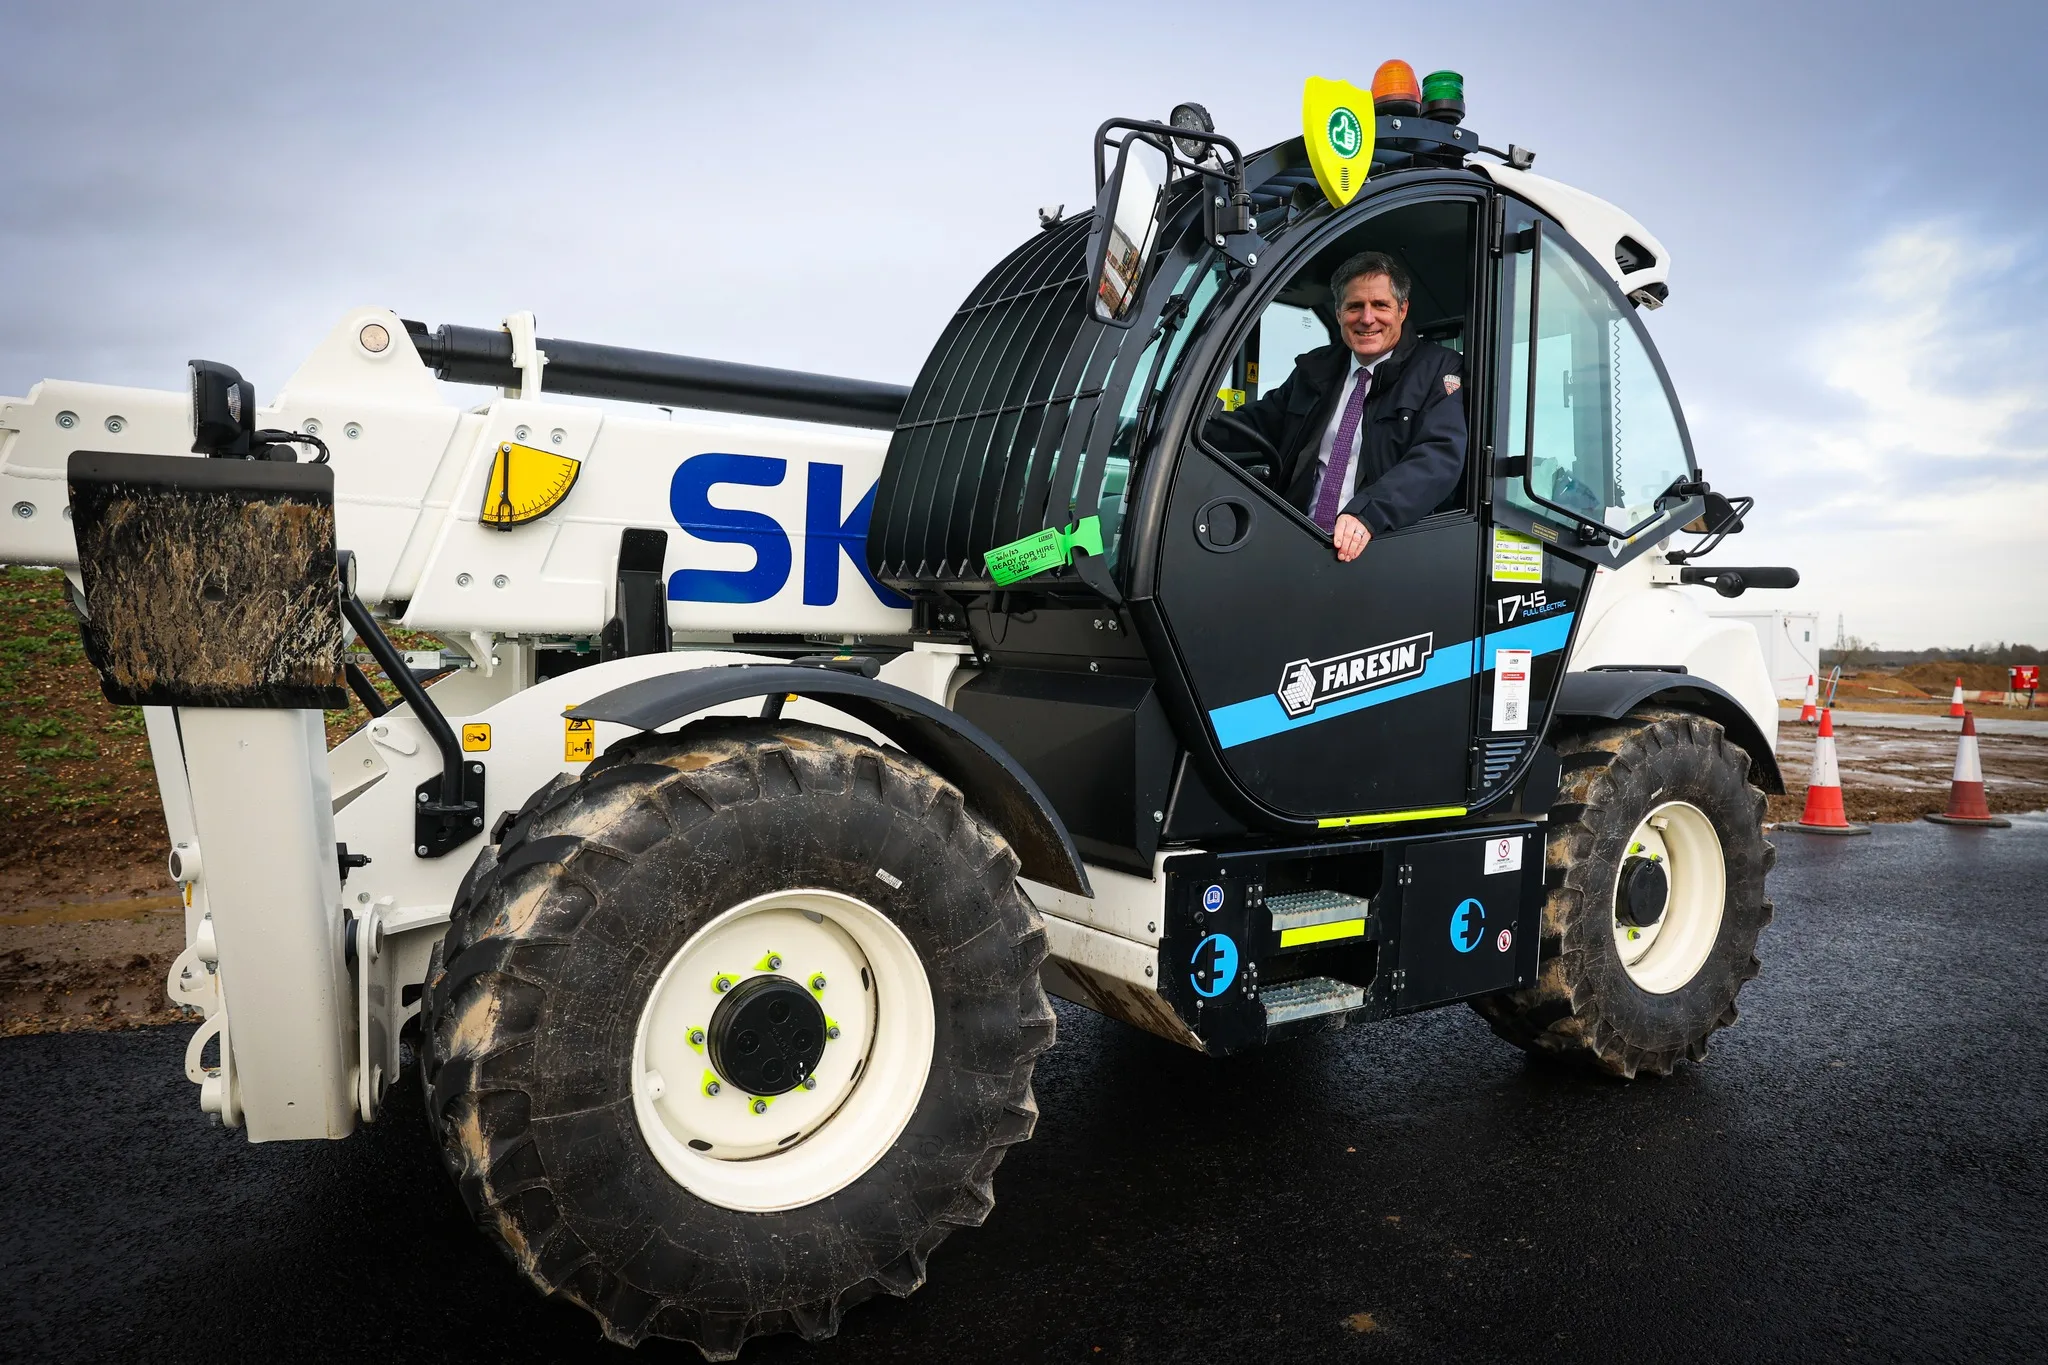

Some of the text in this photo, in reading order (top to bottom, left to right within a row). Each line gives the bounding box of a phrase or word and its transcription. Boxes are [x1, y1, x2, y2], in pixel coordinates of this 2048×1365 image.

[992, 557, 1017, 571] READY
[1019, 550, 1035, 561] FOR
[1036, 544, 1055, 555] HIRE
[1523, 600, 1567, 617] FULL ELECTRIC
[1321, 643, 1416, 692] FARESIN
